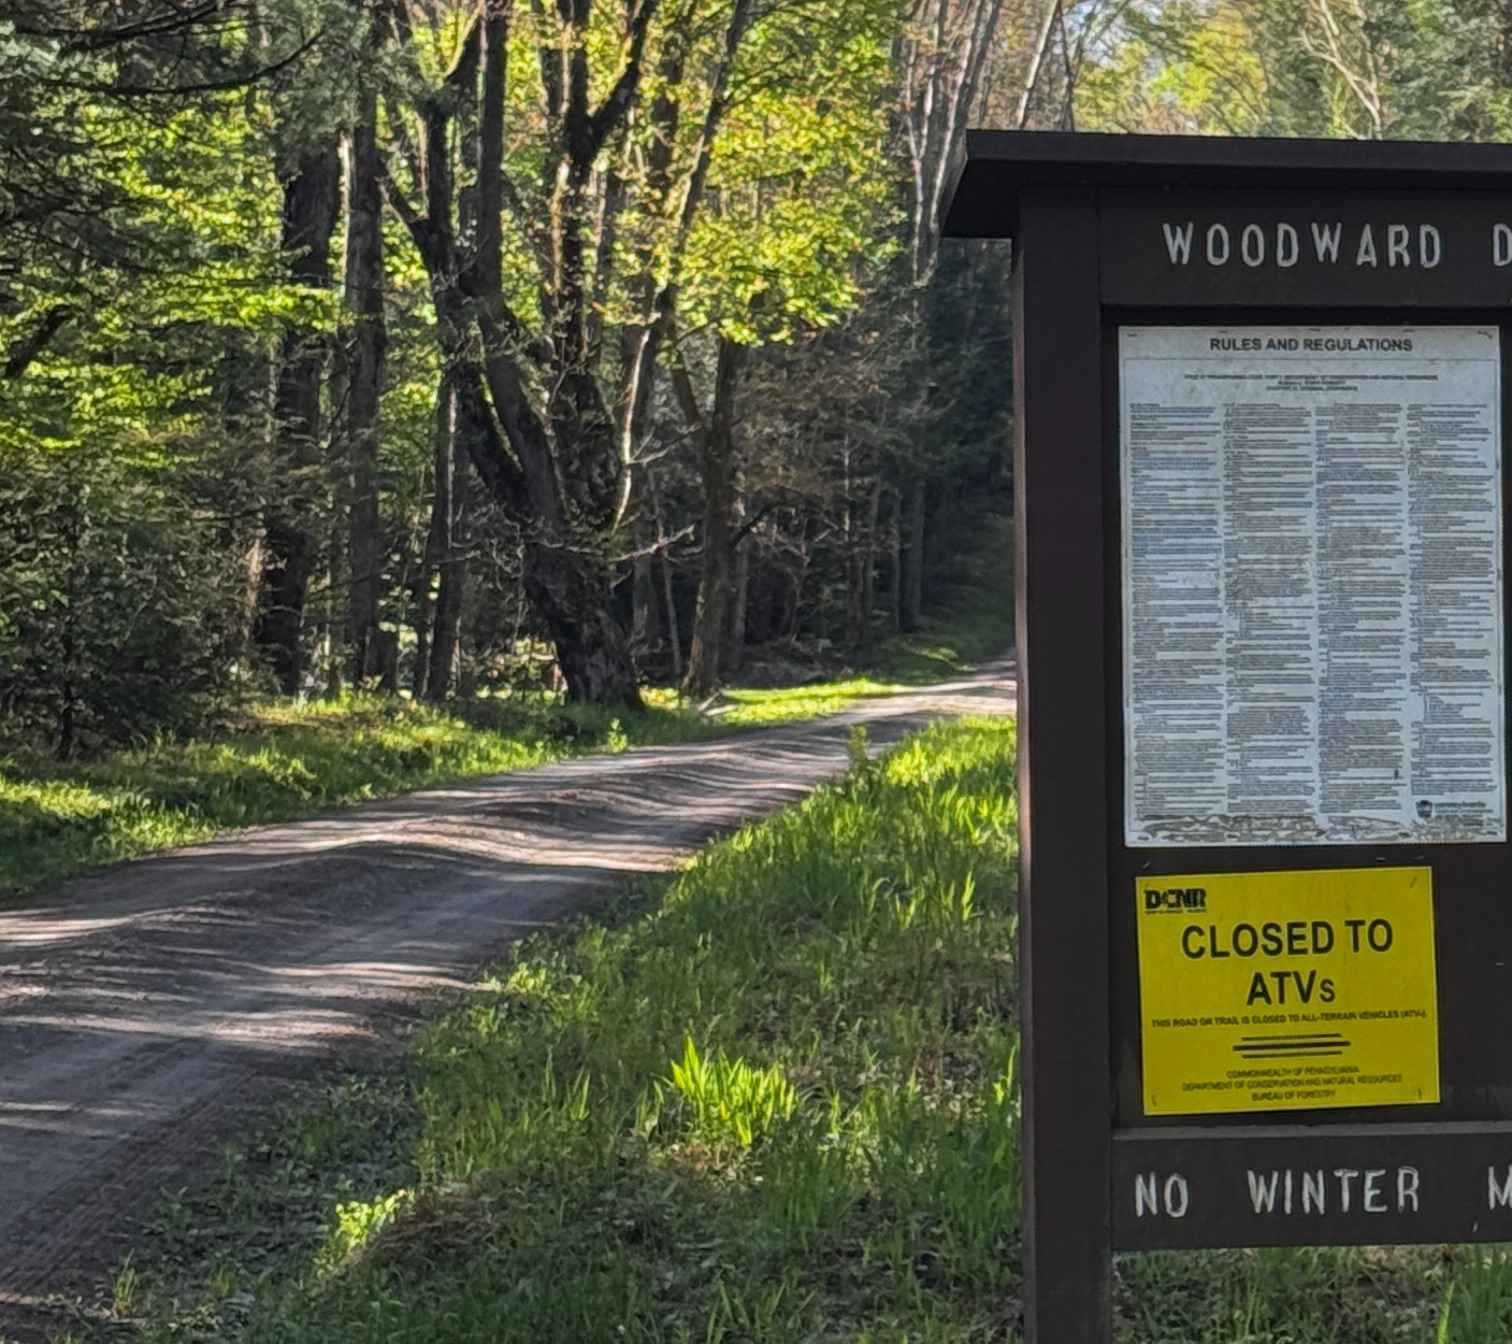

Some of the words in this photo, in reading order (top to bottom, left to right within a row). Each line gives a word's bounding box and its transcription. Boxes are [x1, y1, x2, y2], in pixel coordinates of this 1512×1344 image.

[1162, 221, 1441, 268] WOODWARD
[1210, 338, 1262, 352] RULES
[1265, 338, 1299, 352] AND
[1302, 338, 1413, 352] REGULATIONS
[1181, 920, 1335, 959] CLOSED
[1345, 919, 1393, 953] TO
[1246, 970, 1336, 1006] ATVs
[1134, 1172, 1189, 1218] NO
[1246, 1166, 1420, 1216] WINTER
